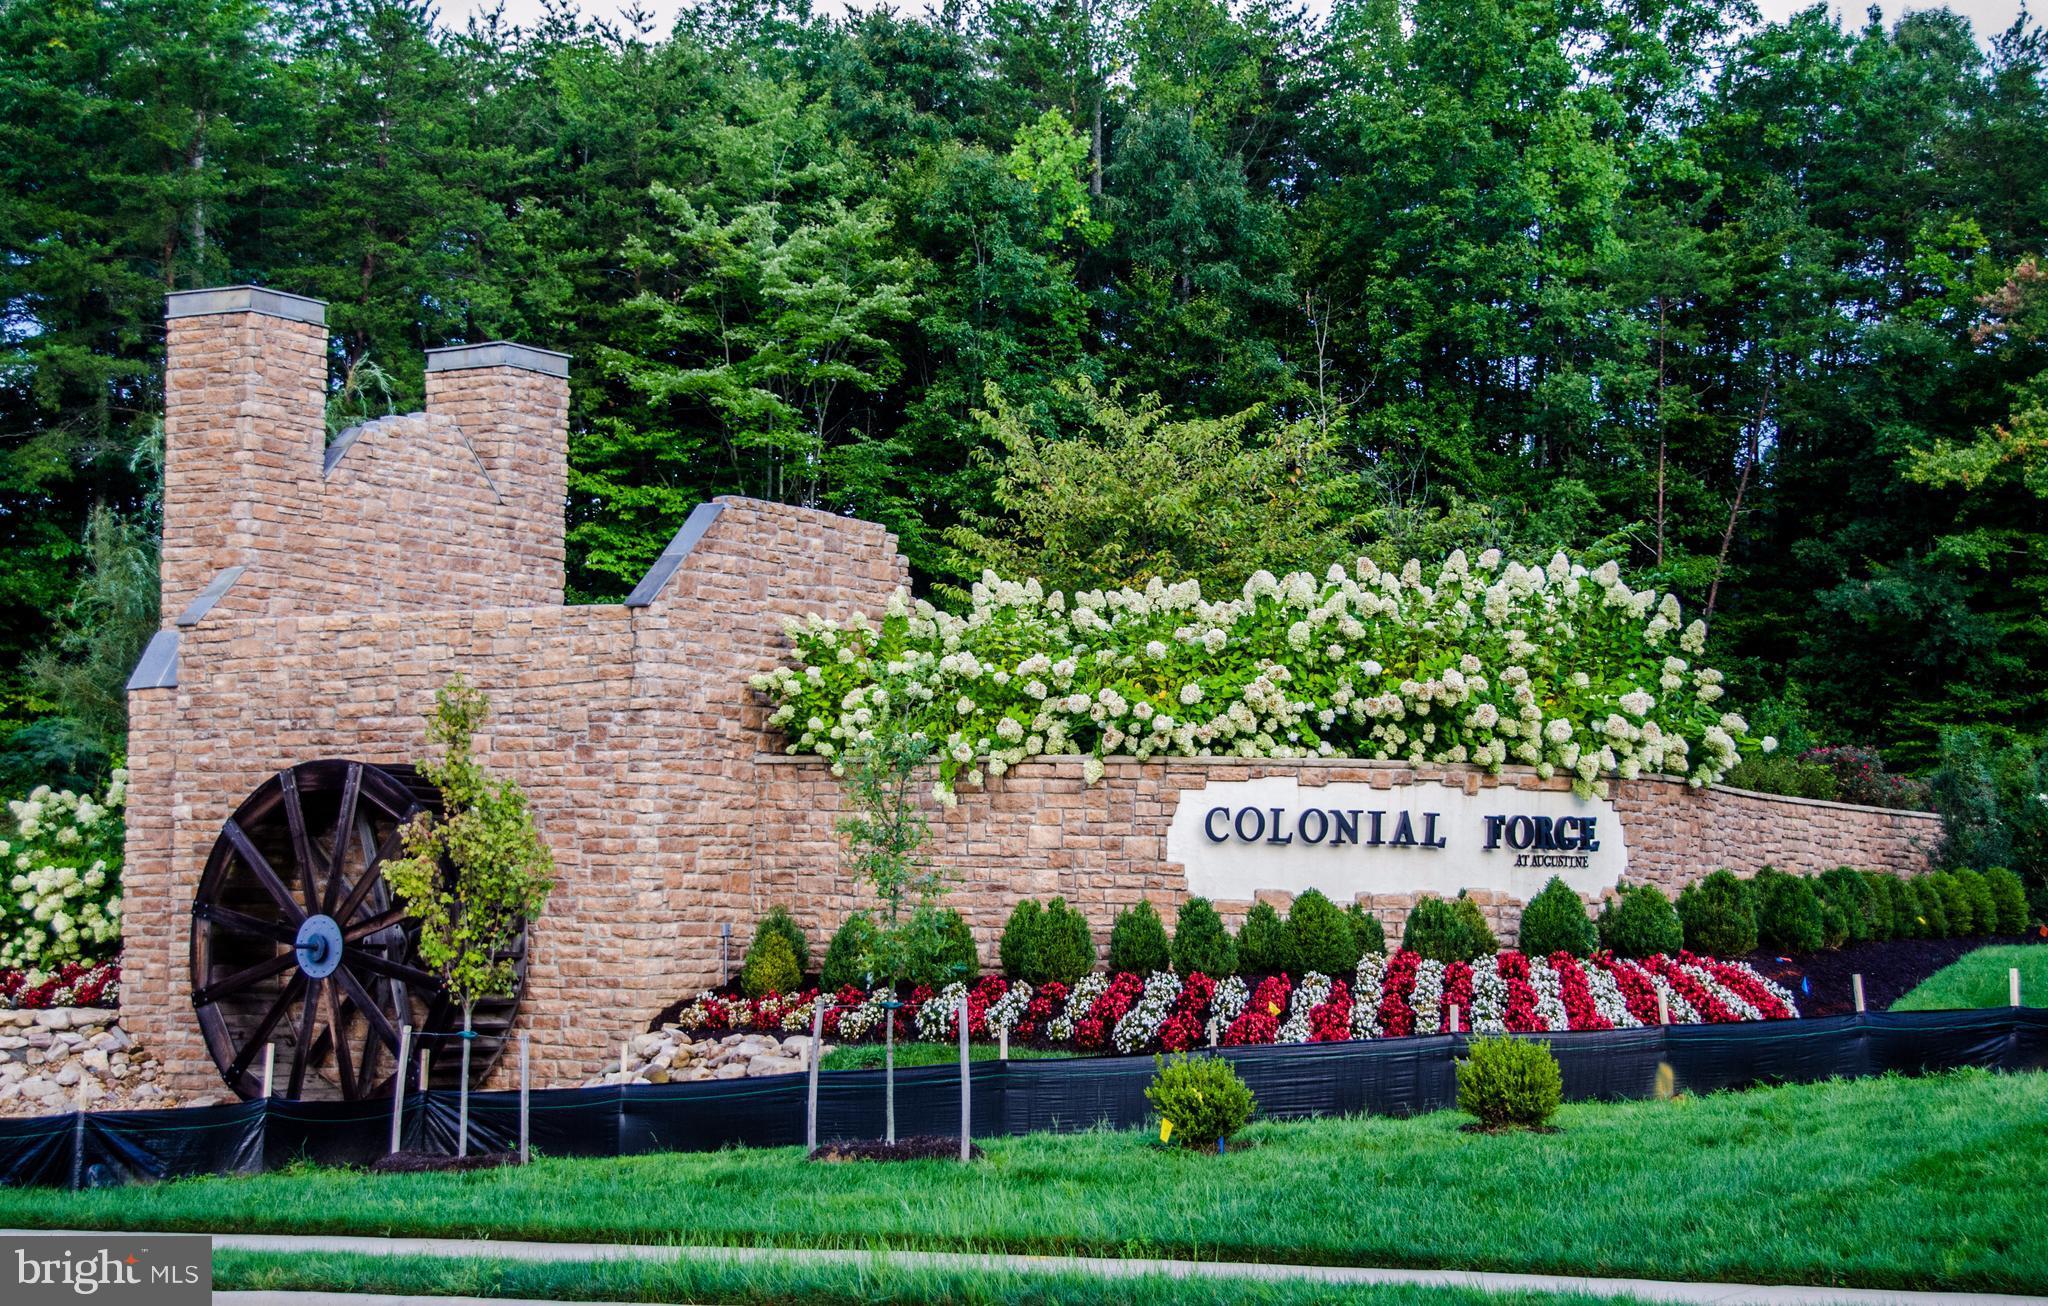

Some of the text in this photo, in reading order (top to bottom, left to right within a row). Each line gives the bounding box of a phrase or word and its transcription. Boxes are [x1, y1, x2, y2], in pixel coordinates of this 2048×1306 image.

[1204, 806, 1601, 852] COLONIAL FORGE
[1514, 854, 1589, 868] AT AUGUSTINE
